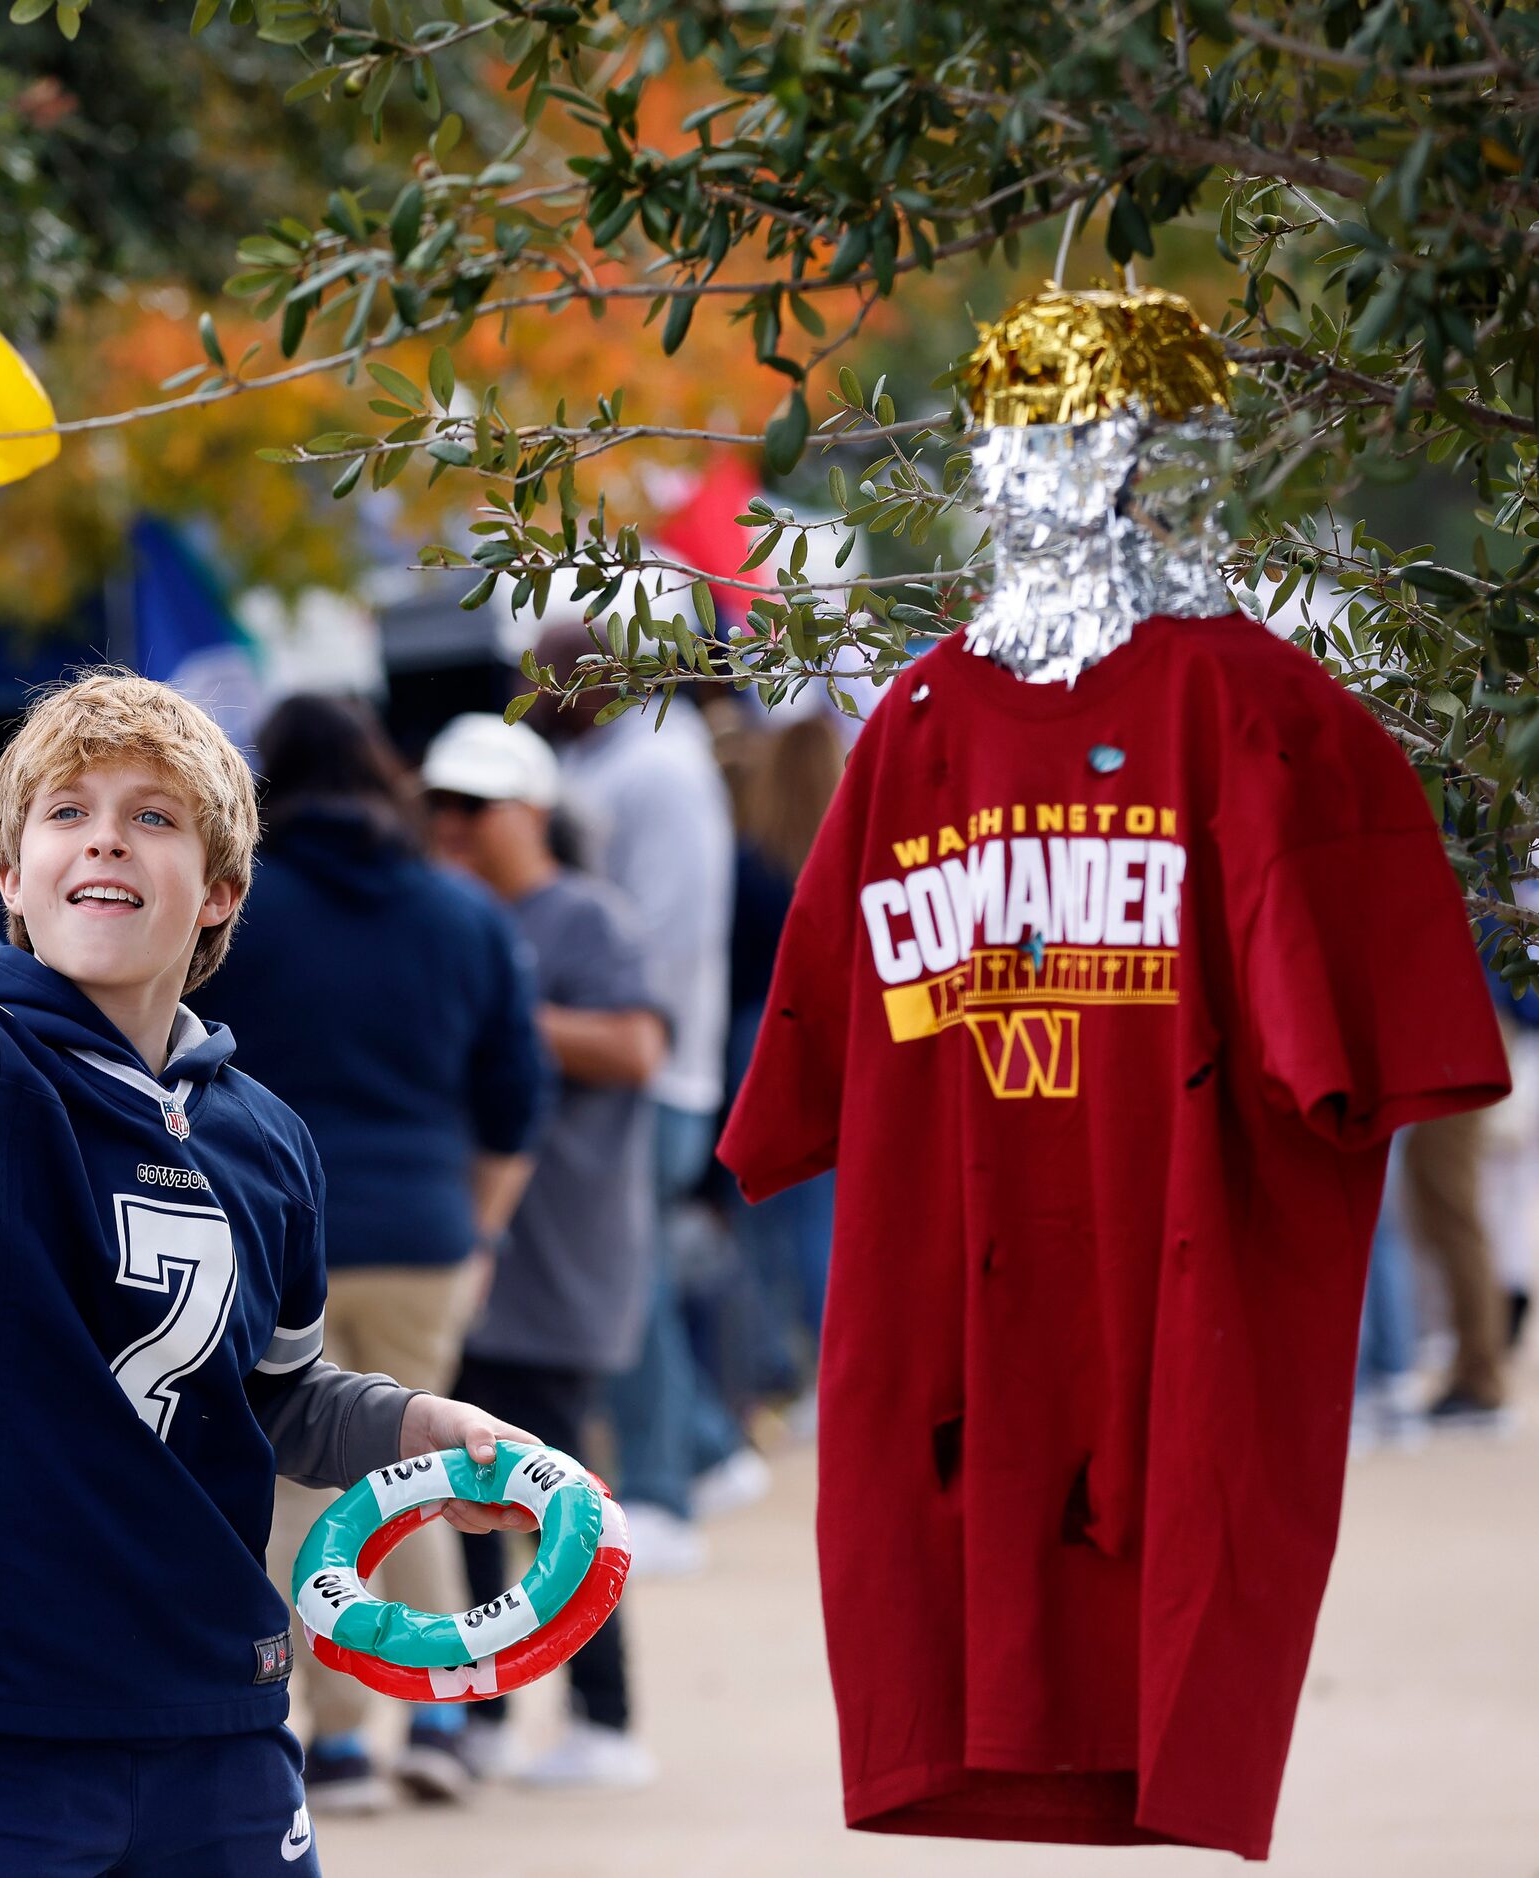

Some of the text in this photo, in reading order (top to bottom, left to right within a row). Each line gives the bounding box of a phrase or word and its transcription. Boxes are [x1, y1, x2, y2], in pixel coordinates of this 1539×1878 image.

[893, 804, 1178, 868] WASHINGTON
[109, 1193, 238, 1444] 7
[375, 1454, 433, 1486] 100
[522, 1454, 566, 1492] 100
[464, 1592, 521, 1629] 100
